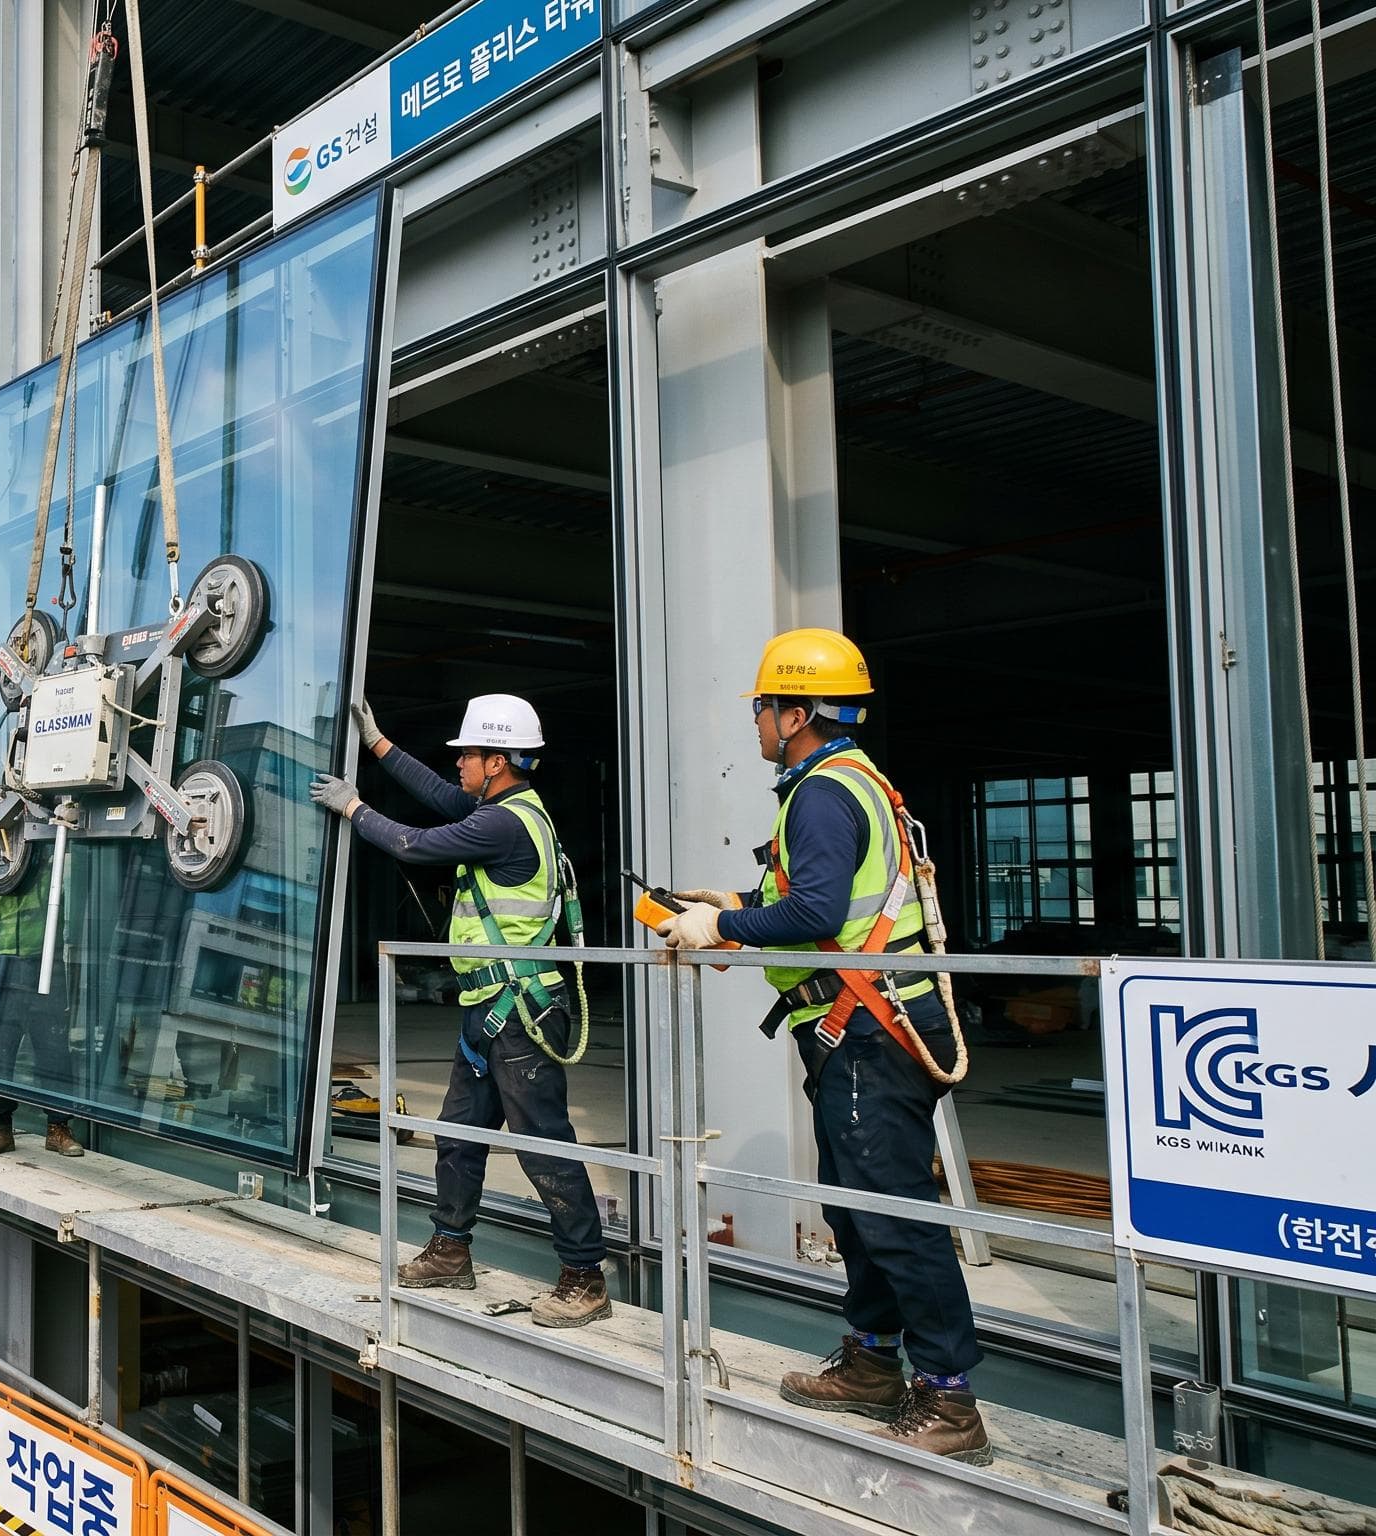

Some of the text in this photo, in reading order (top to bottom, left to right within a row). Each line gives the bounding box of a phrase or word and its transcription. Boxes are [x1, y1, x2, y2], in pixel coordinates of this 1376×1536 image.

[316, 112, 377, 170] GS건설
[401, 59, 464, 118] 메트로
[469, 17, 539, 84] 폴리스
[35, 712, 93, 734] GLASSMAN
[1234, 1060, 1330, 1091] KGS
[1156, 1134, 1191, 1150] KGS
[6, 1430, 118, 1536] 작업중
